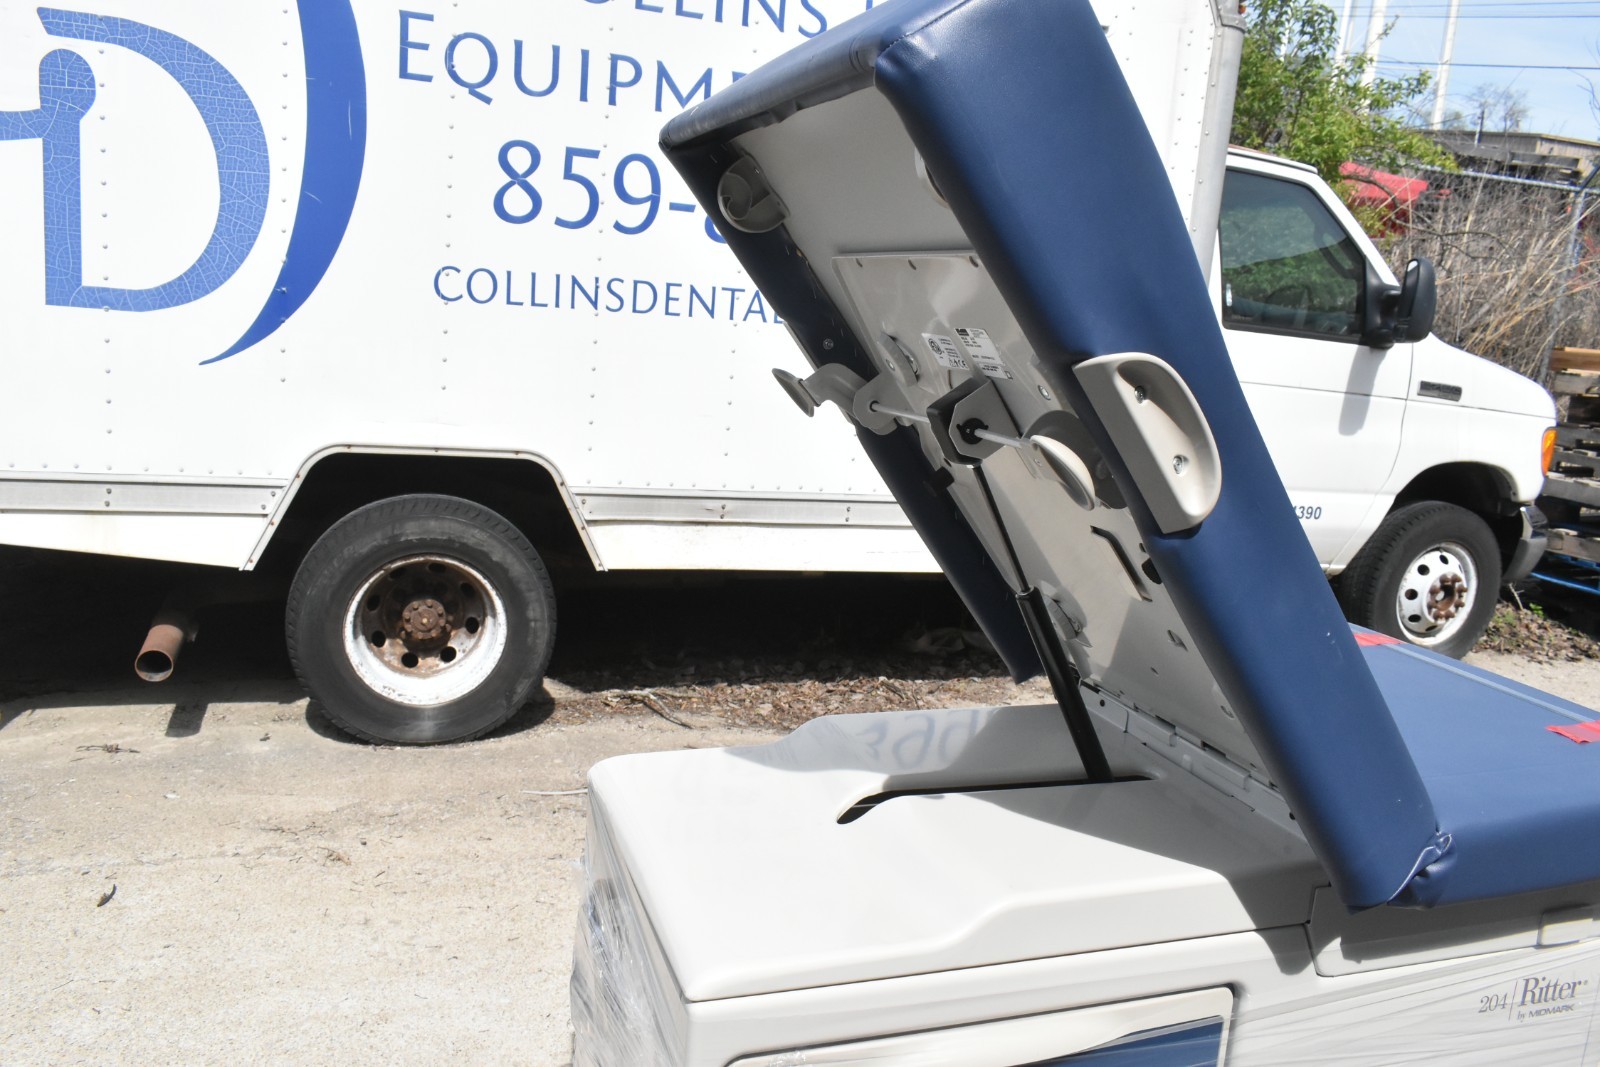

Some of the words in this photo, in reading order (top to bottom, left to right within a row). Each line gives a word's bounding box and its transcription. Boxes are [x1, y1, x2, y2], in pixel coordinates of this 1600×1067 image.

[398, 9, 749, 113] EQUIPM
[493, 139, 729, 244] 859-
[1293, 505, 1322, 520] 390
[1477, 992, 1509, 1014] 204
[1528, 1003, 1575, 1018] MIDMARK
